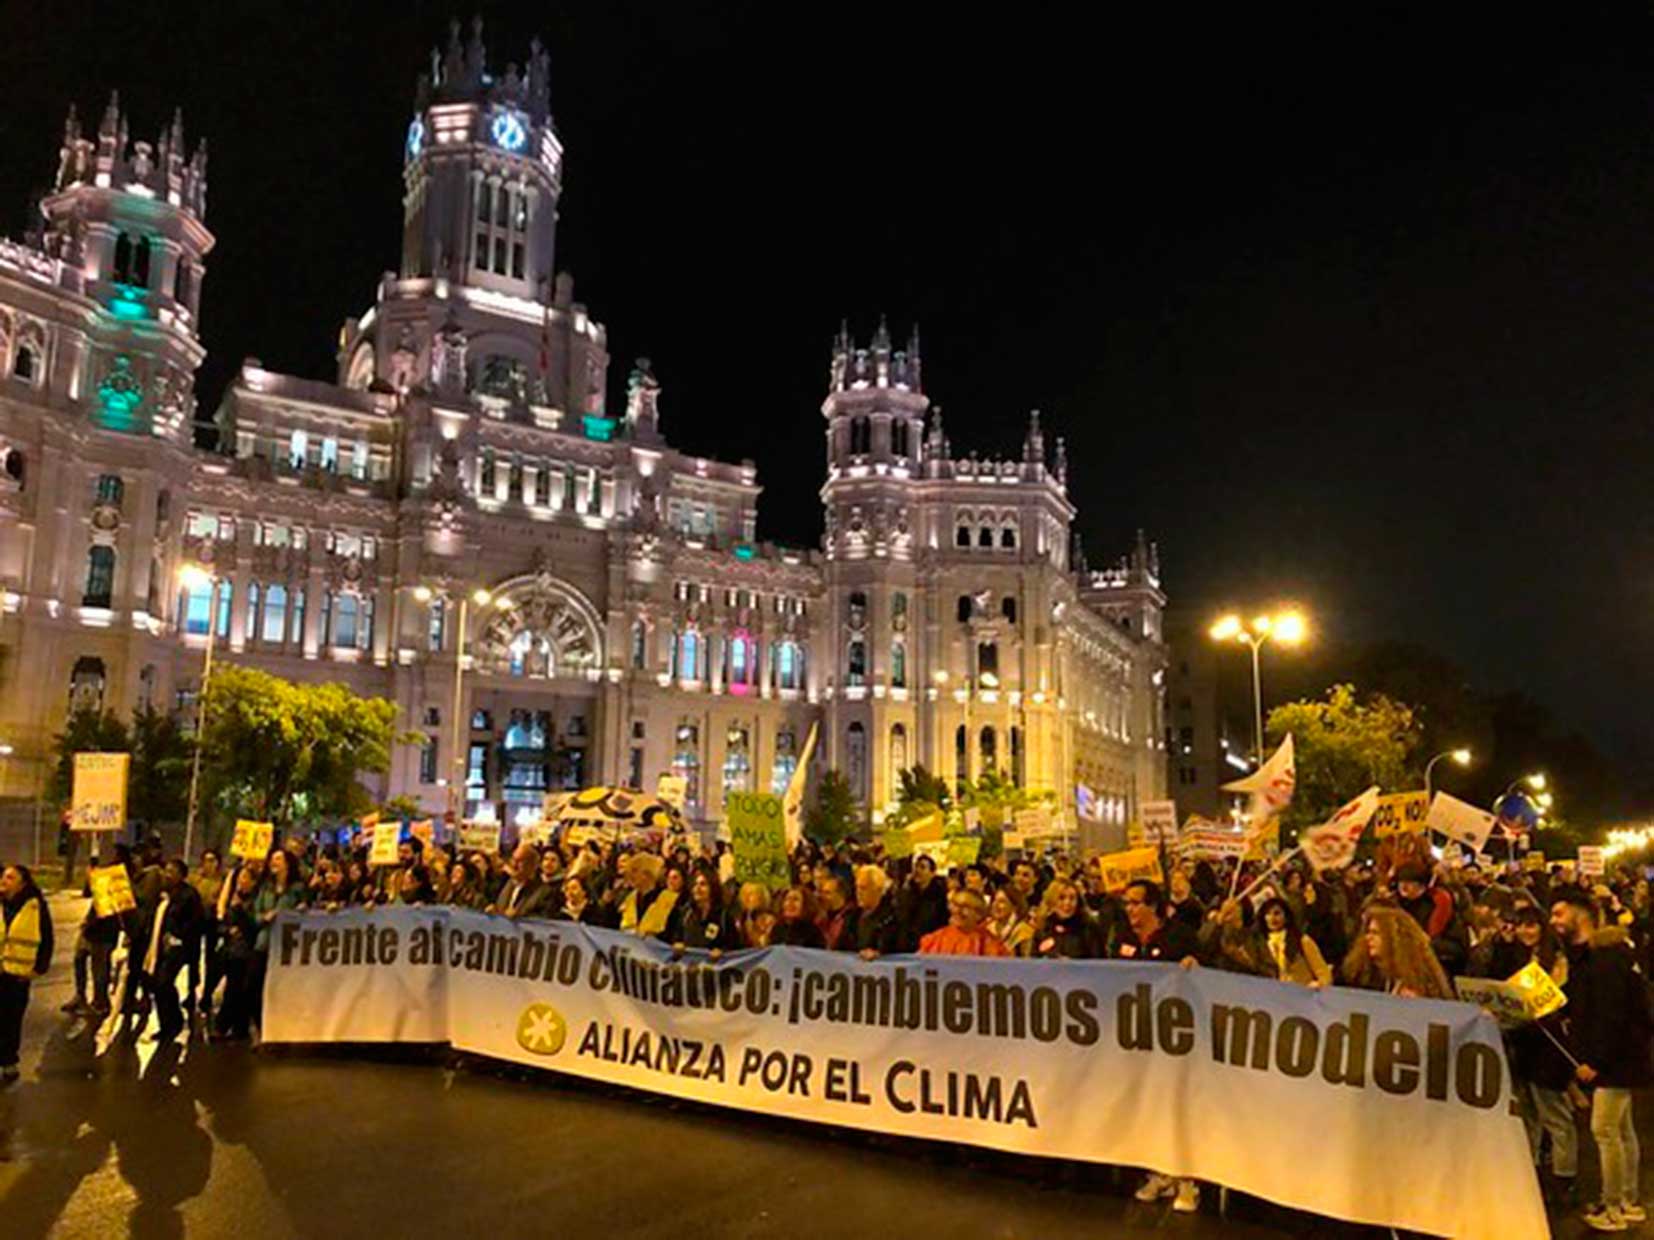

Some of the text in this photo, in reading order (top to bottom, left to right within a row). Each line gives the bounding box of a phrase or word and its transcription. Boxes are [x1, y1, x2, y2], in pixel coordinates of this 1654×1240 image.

[280, 922, 399, 966] Frente
[449, 927, 583, 987] cambio
[788, 967, 1100, 1047] ¡cambiemos
[1116, 983, 1196, 1057] de
[577, 1020, 1039, 1129] ALIANZA POR EL CLIMA
